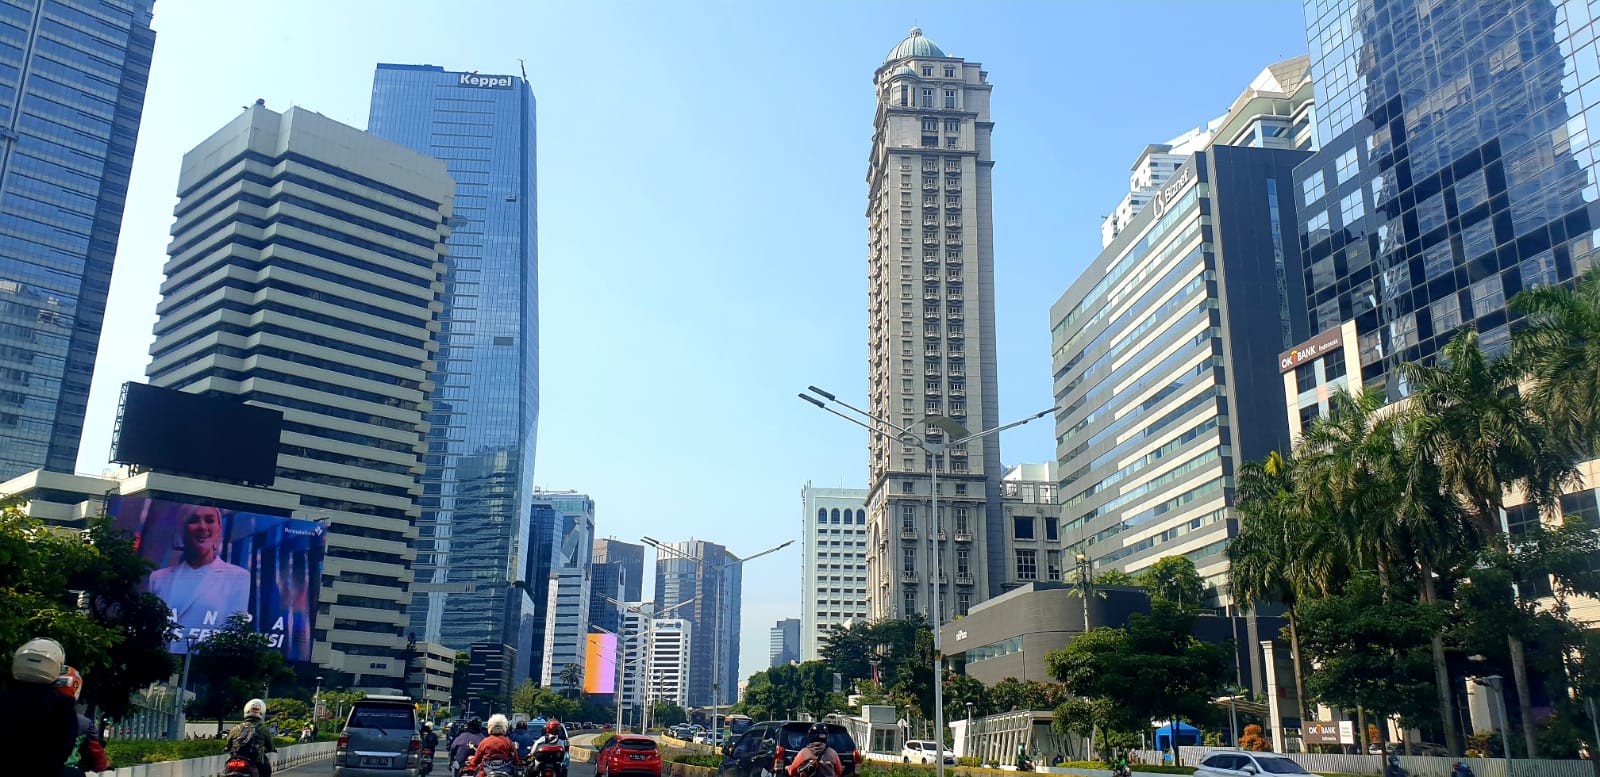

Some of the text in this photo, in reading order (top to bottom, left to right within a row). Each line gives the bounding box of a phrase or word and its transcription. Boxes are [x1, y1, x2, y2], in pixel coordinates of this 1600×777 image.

[460, 74, 512, 87] Keppel
[1165, 167, 1190, 204] Biznet
[1281, 356, 1293, 369] OK
[1297, 345, 1316, 361] BANK
[1308, 726, 1318, 735] OK
